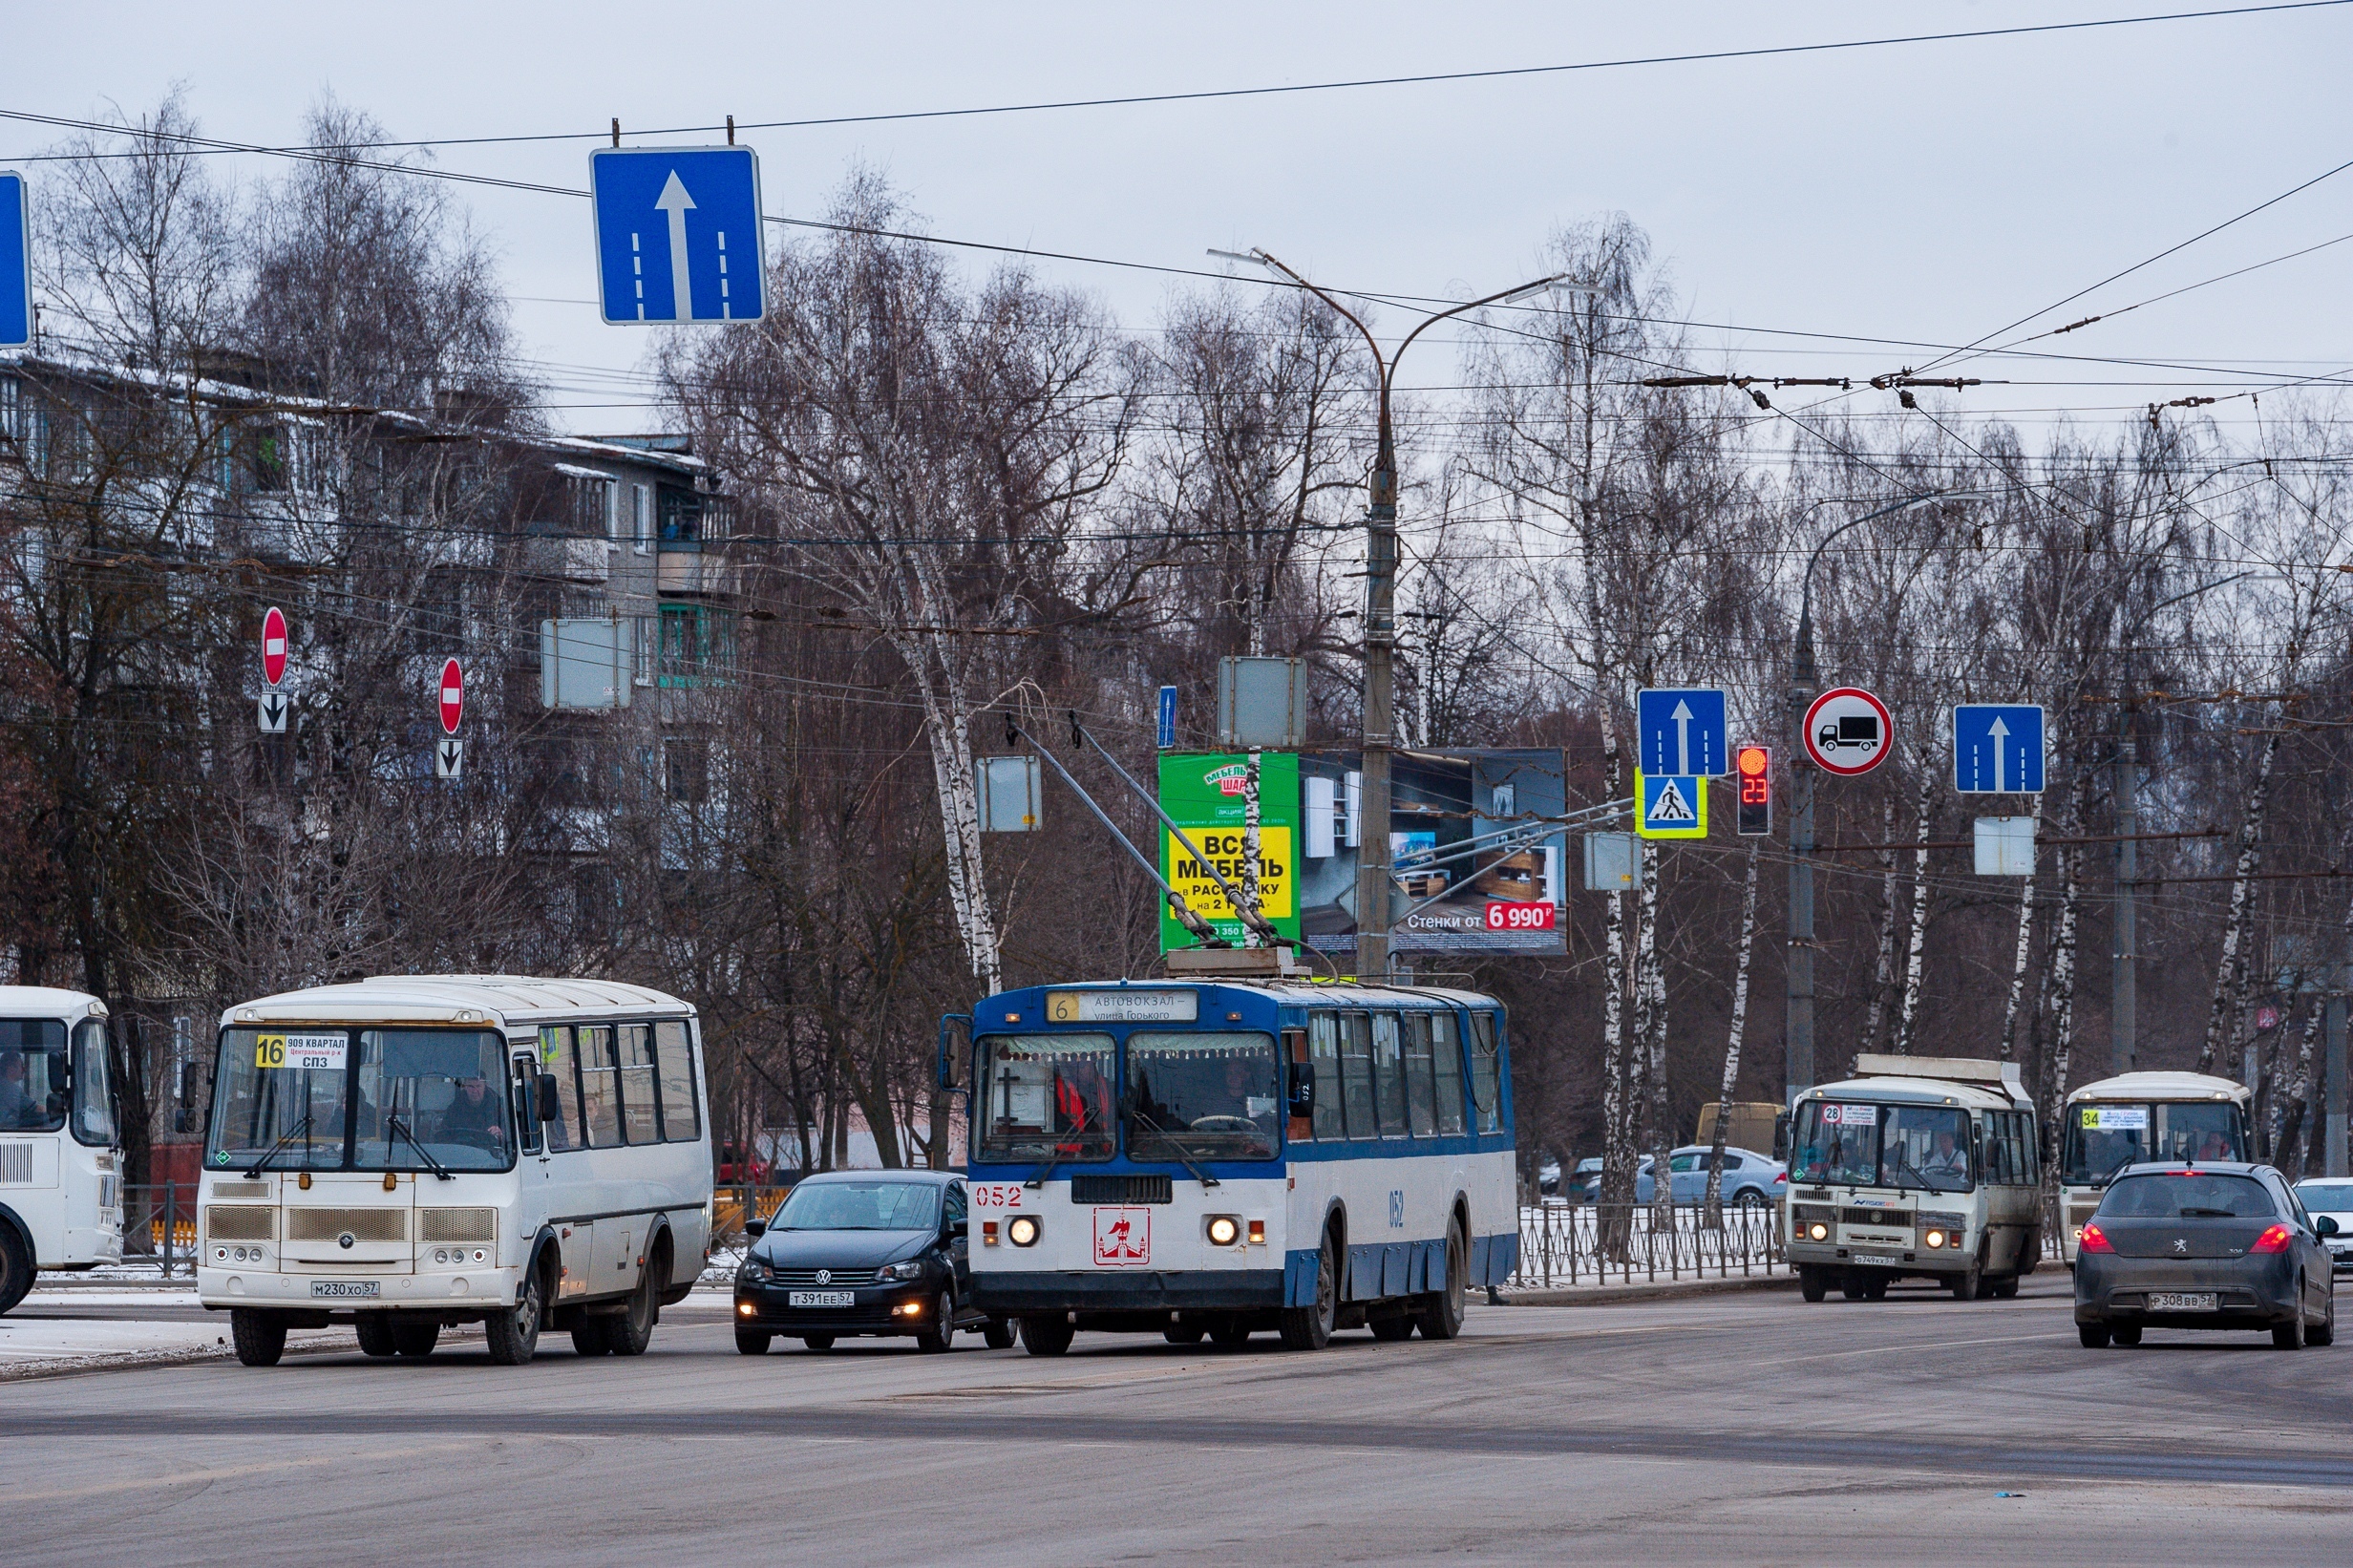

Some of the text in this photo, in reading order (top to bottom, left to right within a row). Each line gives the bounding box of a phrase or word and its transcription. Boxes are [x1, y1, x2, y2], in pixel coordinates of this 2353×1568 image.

[1206, 766, 1246, 783] МЕБЕЛЬ
[1223, 778, 1247, 792] ШАР
[1743, 778, 1767, 803] 23
[1214, 899, 1221, 909] 2
[1408, 914, 1461, 928] Стенки
[1464, 917, 1482, 928] от
[1489, 904, 1504, 927] 6
[1509, 907, 1544, 928] 990
[1055, 996, 1175, 1020] 6 АВТОВОКЗАЛ
[1094, 1010, 1170, 1021] улица Горького
[258, 1038, 345, 1065] 16 909 КВАРТАЛ
[303, 1056, 328, 1068] СПЗ
[1826, 1108, 1838, 1119] 28
[2083, 1112, 2099, 1126] 34
[976, 1186, 1022, 1207] 052
[1388, 1190, 1404, 1228] 052
[315, 1282, 376, 1296] М230ХО 57
[794, 1292, 851, 1304] Т391ЕЕ 57
[2153, 1294, 2212, 1306] Р308ВВ 57
